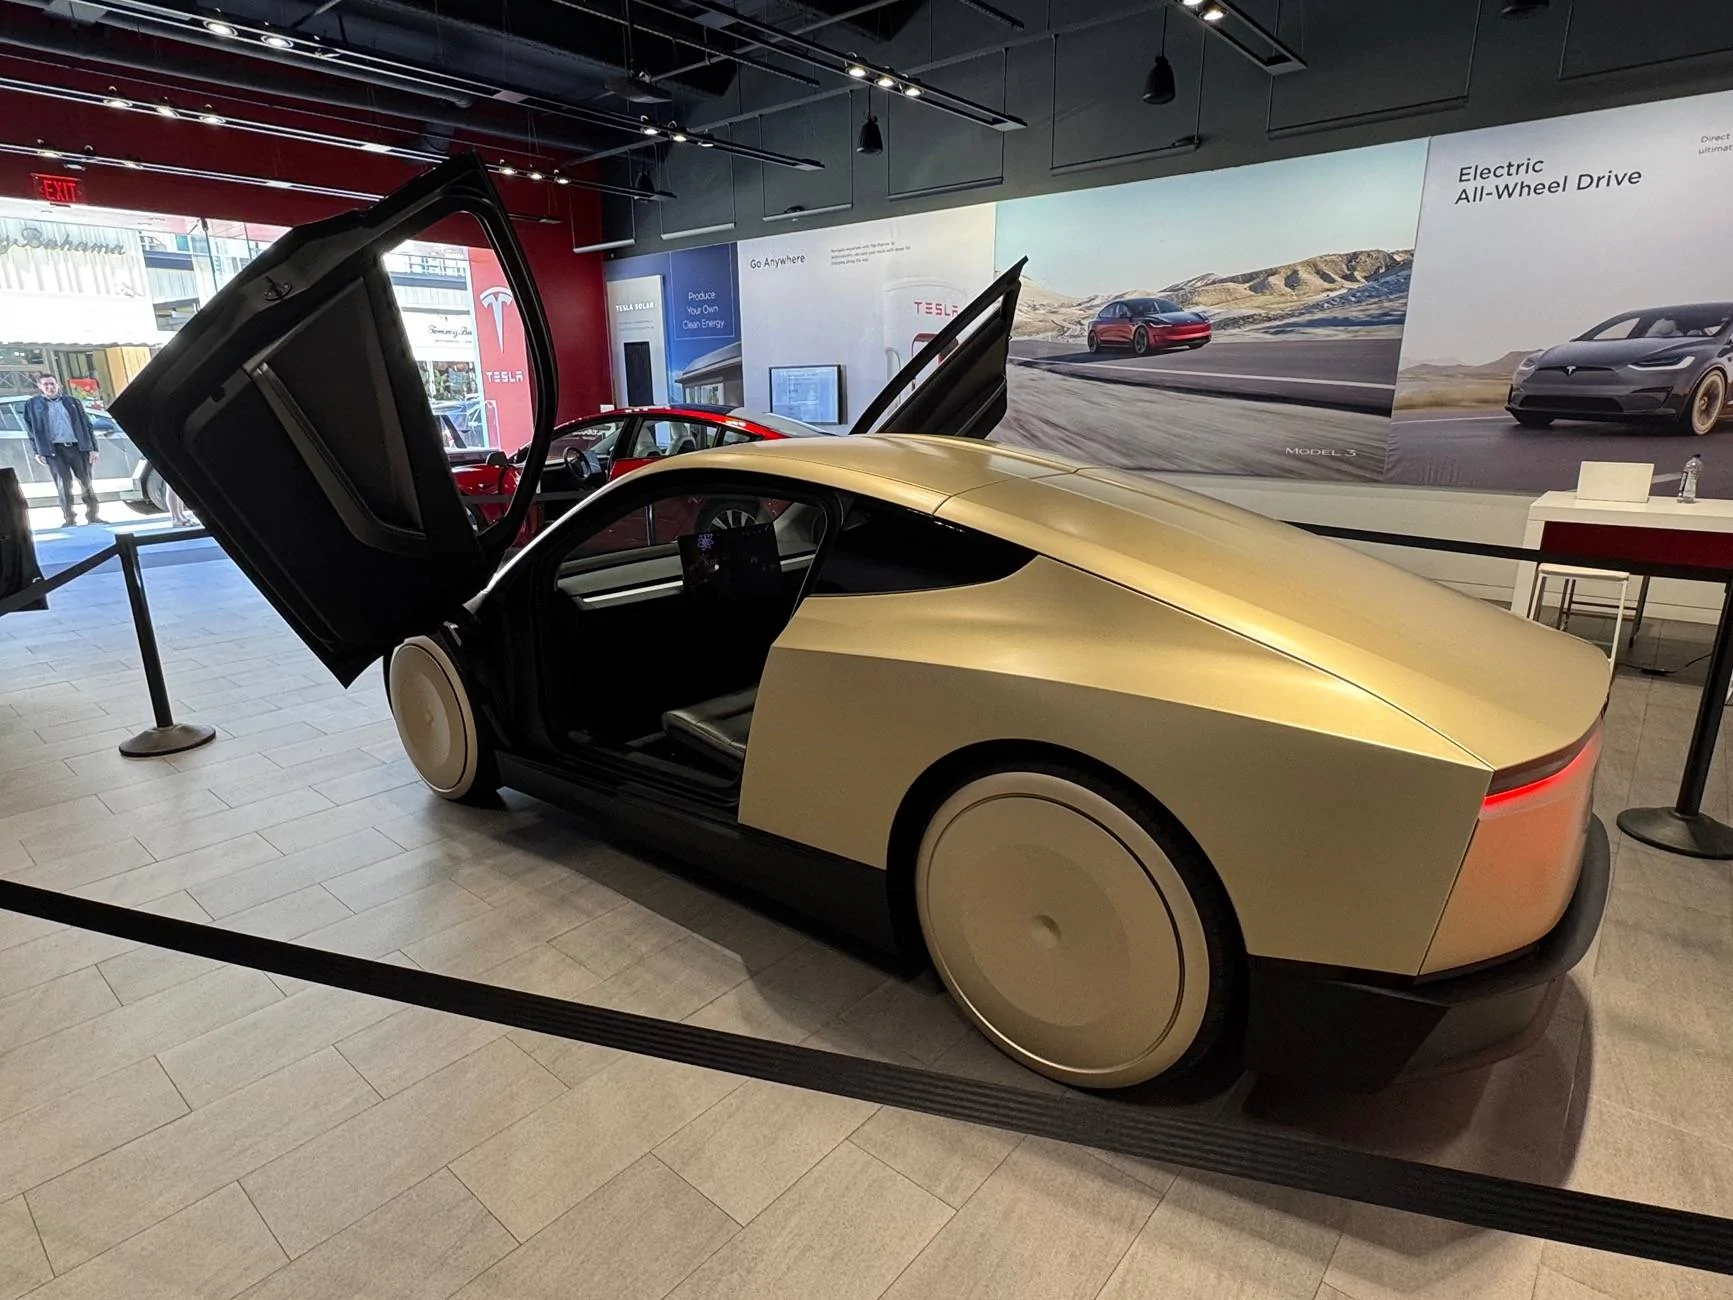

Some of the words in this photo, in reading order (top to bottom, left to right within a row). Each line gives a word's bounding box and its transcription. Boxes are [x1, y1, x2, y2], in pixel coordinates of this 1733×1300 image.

[1700, 133, 1730, 143] Direct
[1458, 158, 1544, 183] Electric
[43, 180, 76, 201] EXIT
[1454, 175, 1567, 205] All-Wheel
[1576, 170, 1642, 191] Drive
[750, 259, 761, 269] Go
[764, 255, 805, 268] Anywhere
[688, 291, 716, 302] Produce
[616, 303, 633, 313] TESLA
[635, 301, 654, 311] SOLAR
[687, 306, 701, 316] Your
[702, 304, 719, 315] Own
[914, 301, 959, 317] TESLA
[682, 320, 701, 330] Clean
[702, 319, 724, 330] Energy
[486, 371, 523, 383] TESLA
[1285, 447, 1342, 457] MODEL
[1344, 448, 1357, 457] 3
